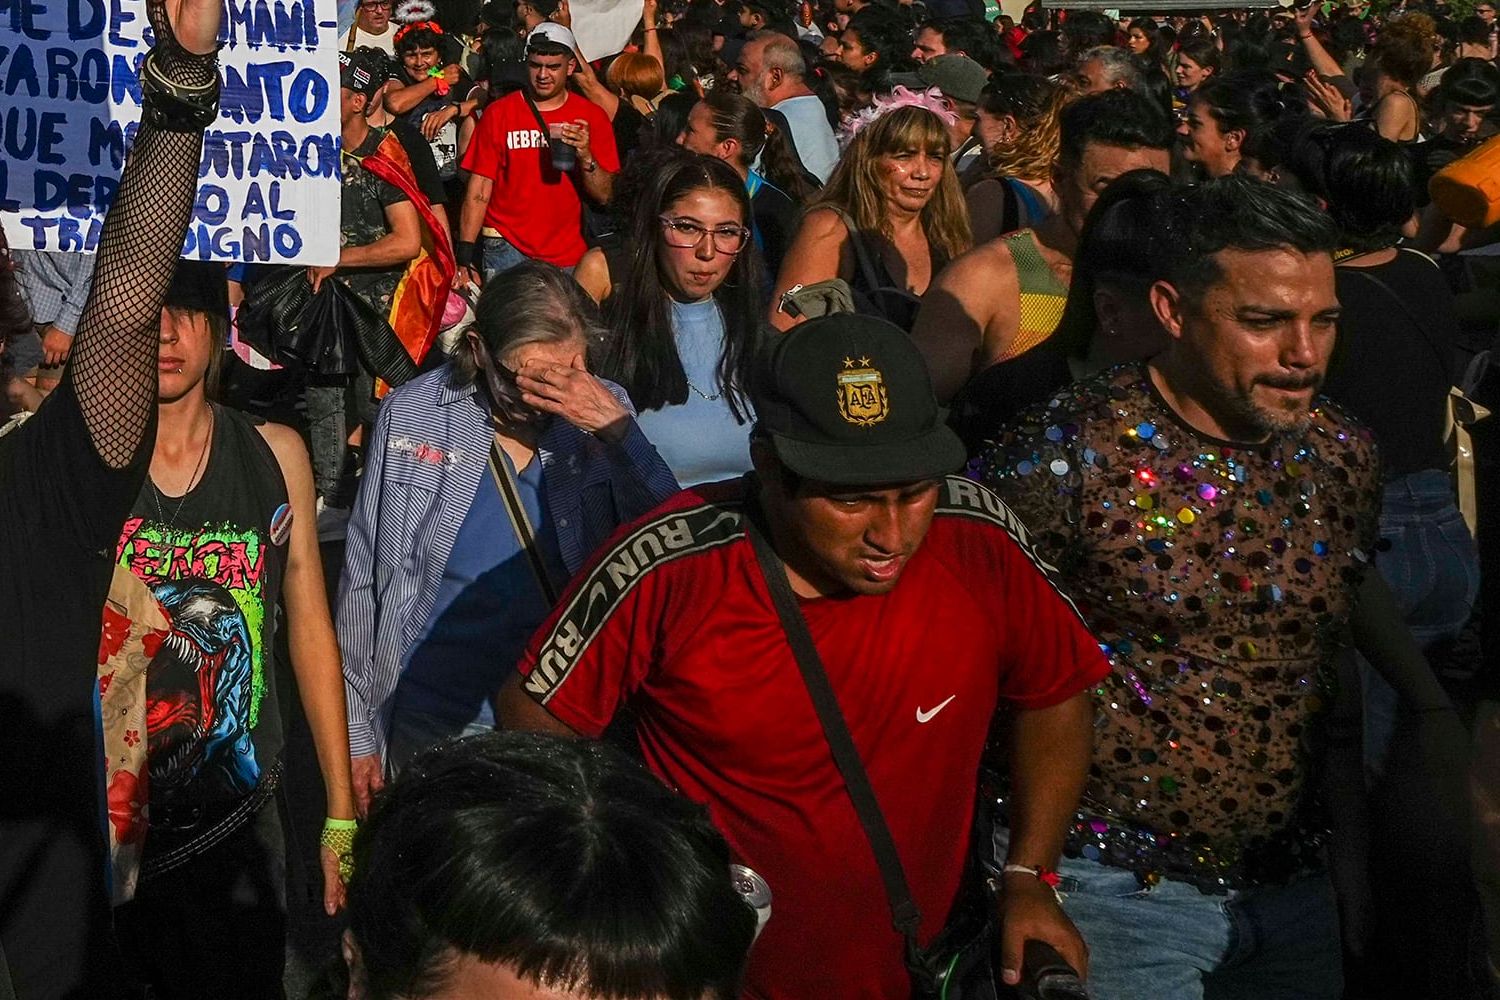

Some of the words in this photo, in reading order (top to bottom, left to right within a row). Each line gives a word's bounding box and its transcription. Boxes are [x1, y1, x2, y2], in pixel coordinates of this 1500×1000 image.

[241, 181, 297, 221] AL
[850, 383, 877, 410] AFA
[946, 479, 1030, 548] RUN
[605, 518, 695, 591] RUN
